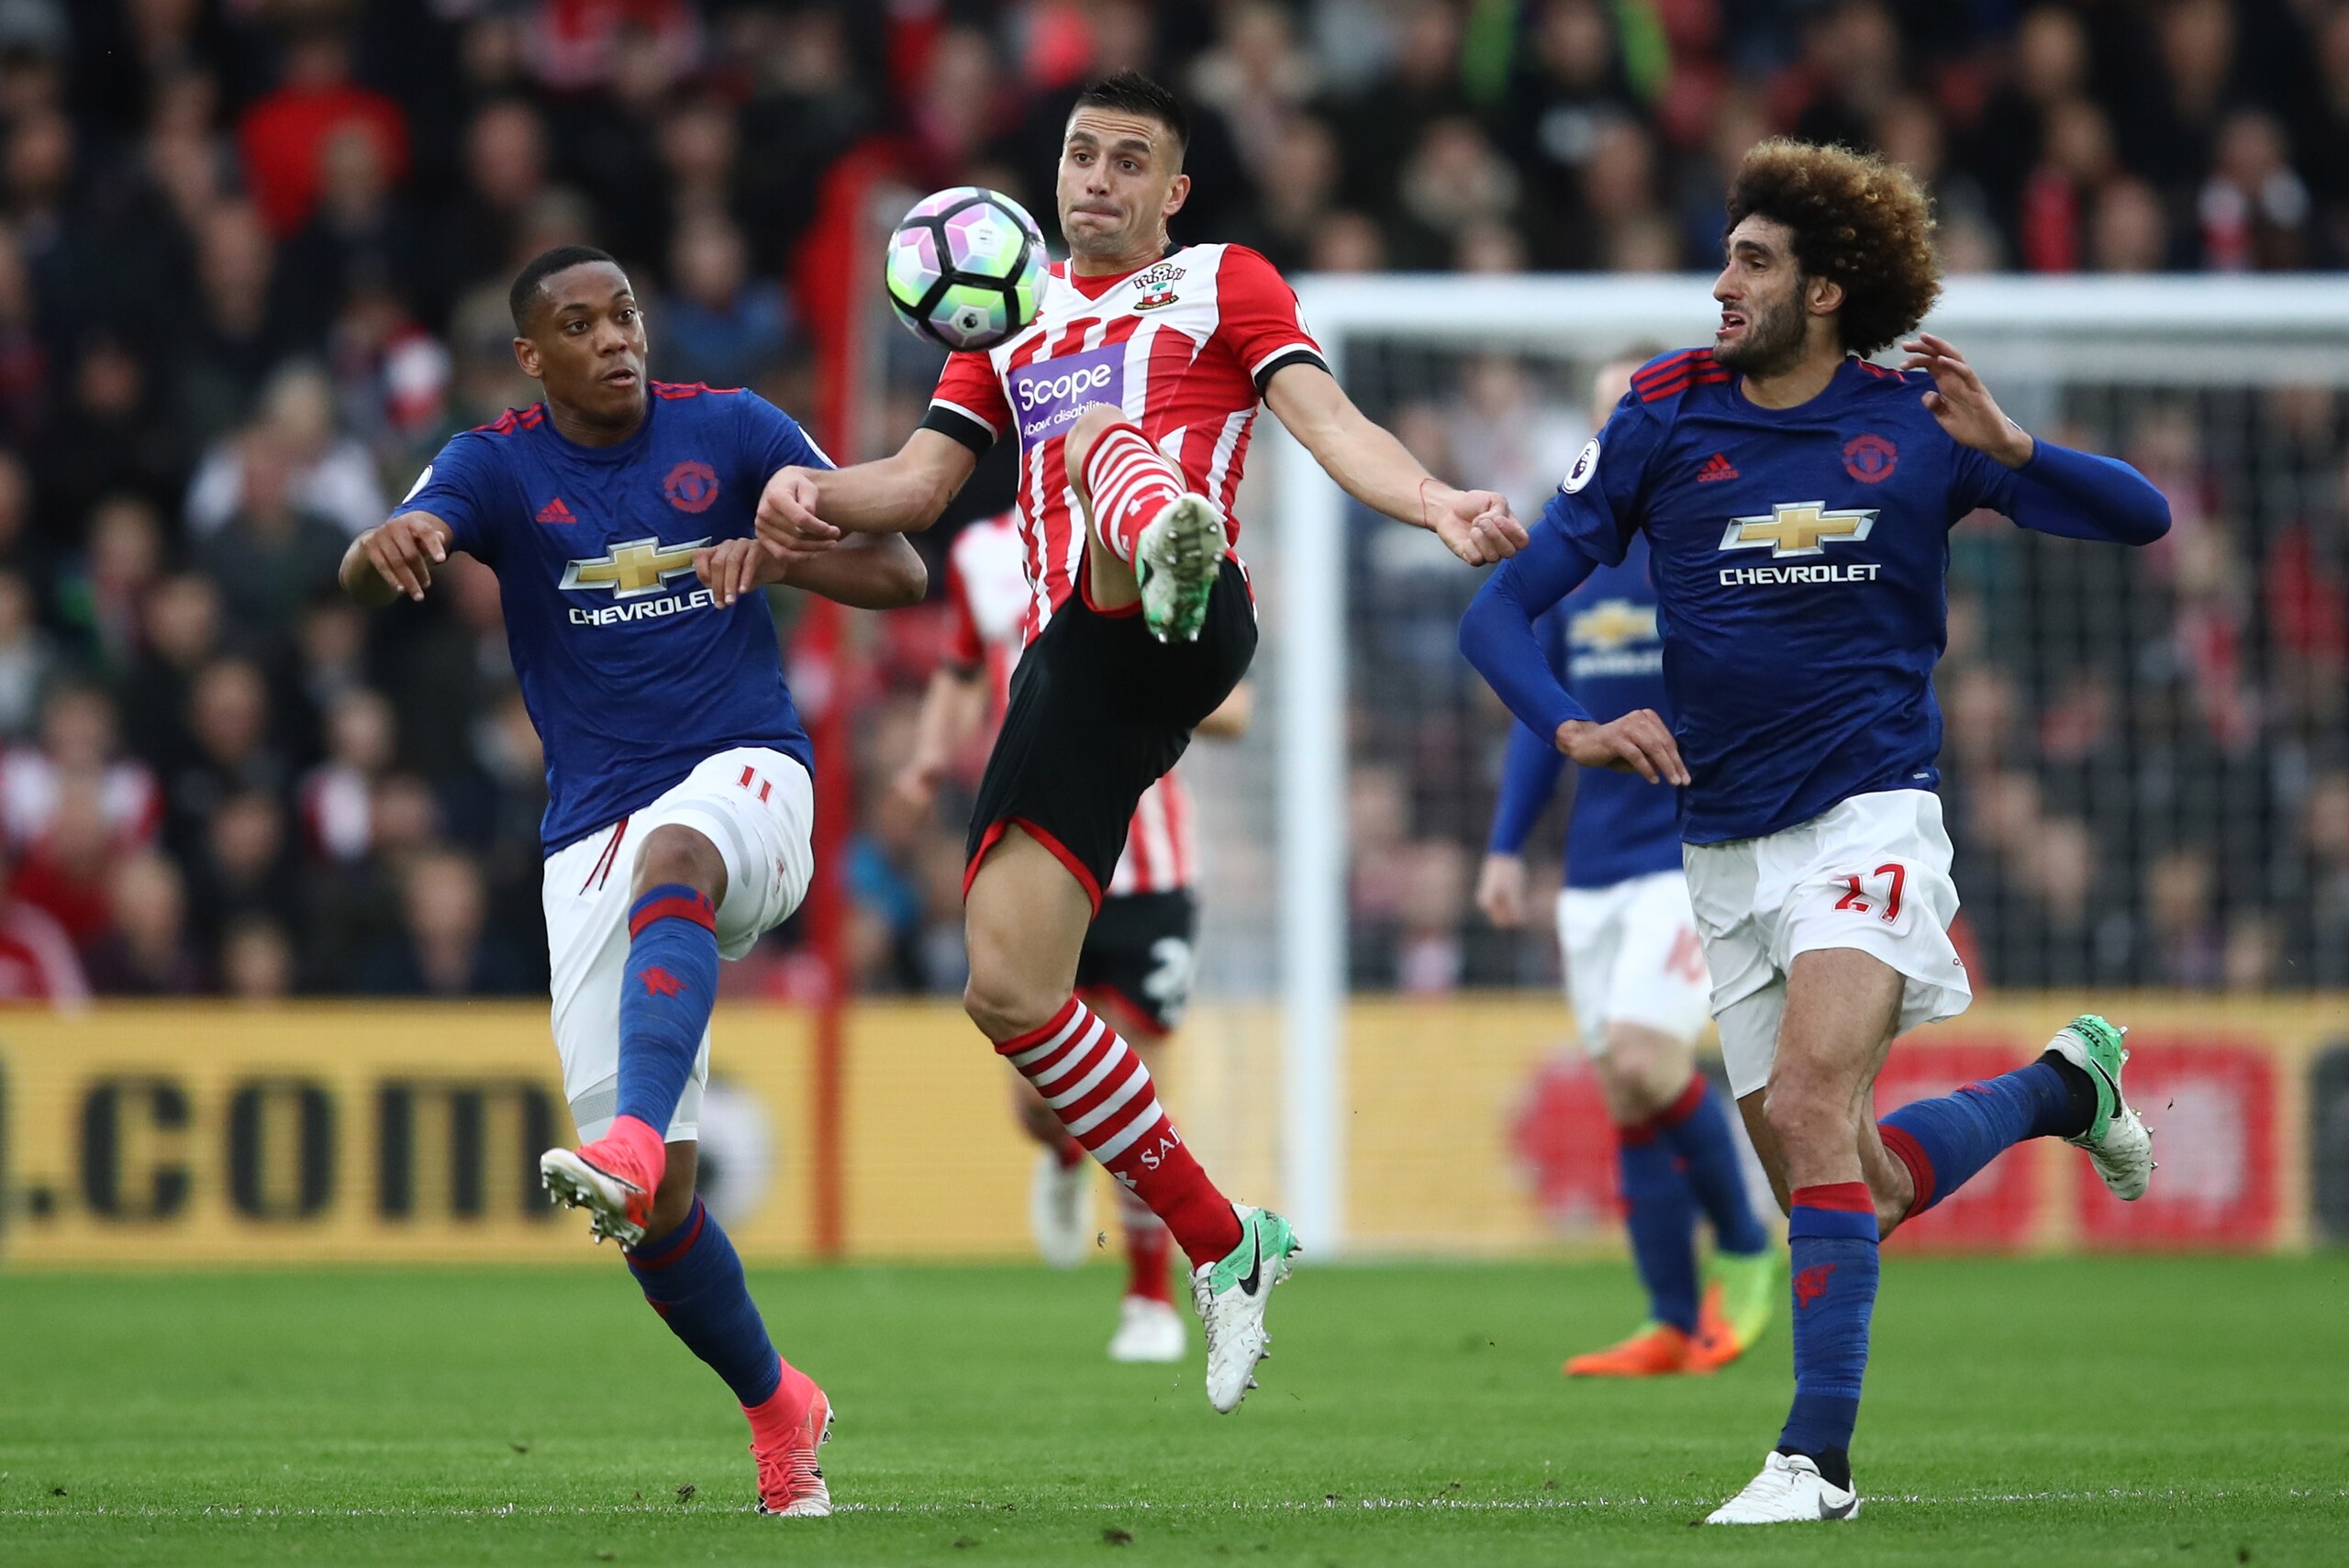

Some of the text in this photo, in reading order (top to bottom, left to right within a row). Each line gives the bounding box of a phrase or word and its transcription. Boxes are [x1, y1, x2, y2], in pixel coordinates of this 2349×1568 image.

[1019, 364, 1111, 412] Scope
[1720, 563, 1882, 586] CHEVROLET
[736, 763, 774, 806] 11
[1830, 861, 1907, 926] 27
[0, 1069, 563, 1224] .com
